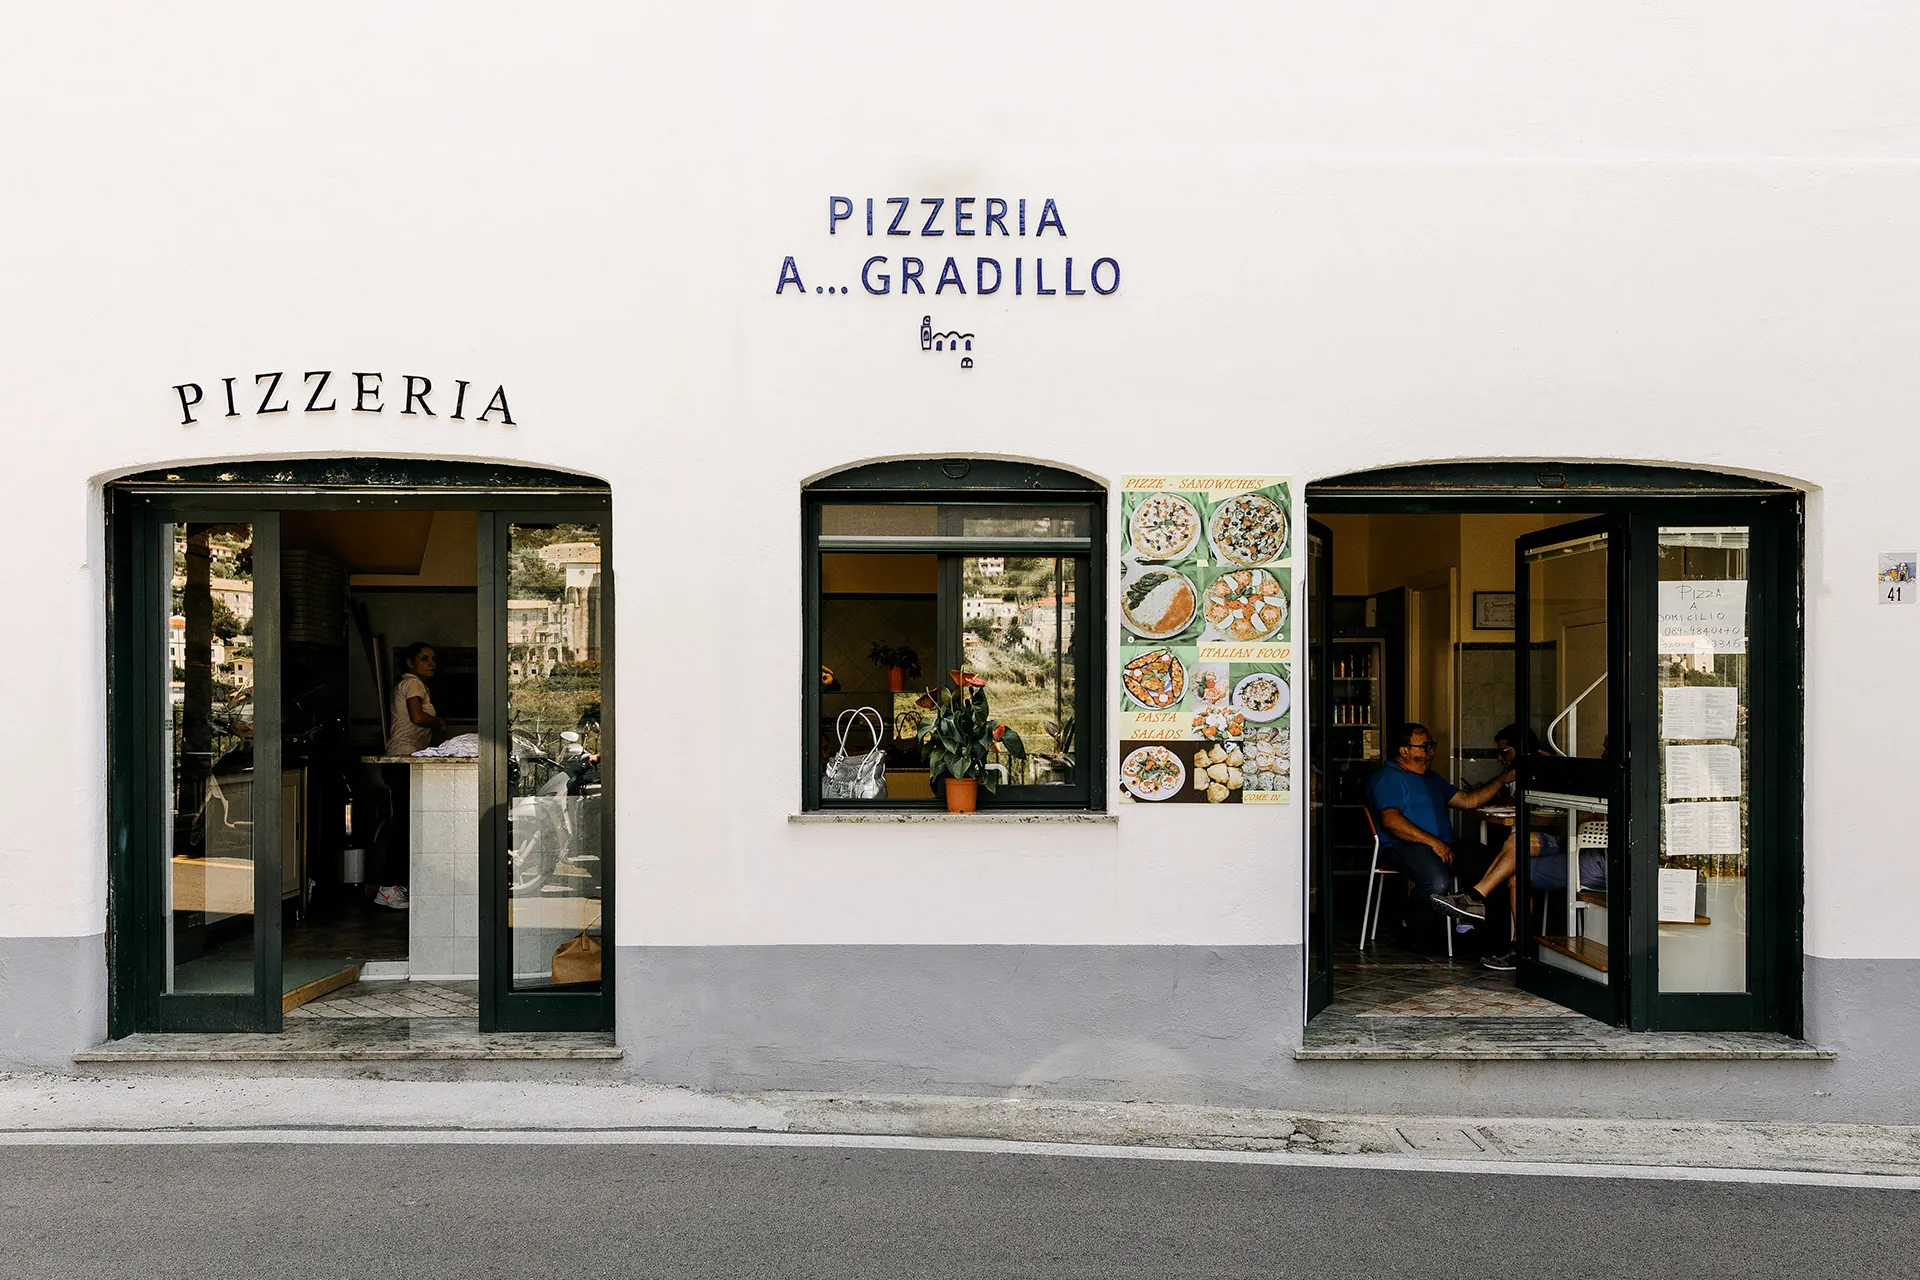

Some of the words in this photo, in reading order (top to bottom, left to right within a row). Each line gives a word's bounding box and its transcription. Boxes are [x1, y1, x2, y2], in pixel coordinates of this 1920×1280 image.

[829, 195, 1067, 237] PIZZERIA
[861, 255, 1122, 296] GRADILLO
[171, 370, 517, 426] PIZZERIA
[1125, 478, 1166, 489] PIZZE
[1178, 478, 1265, 490] SANDWICHES
[1676, 584, 1723, 600] PIZZA
[1887, 586, 1902, 602] 41
[1689, 601, 1698, 610] A
[1199, 647, 1255, 659] ITALIAN
[1255, 647, 1291, 659] FOOD
[1134, 711, 1177, 723] PASTA
[1130, 728, 1184, 739] SALADS
[1243, 793, 1269, 801] COME
